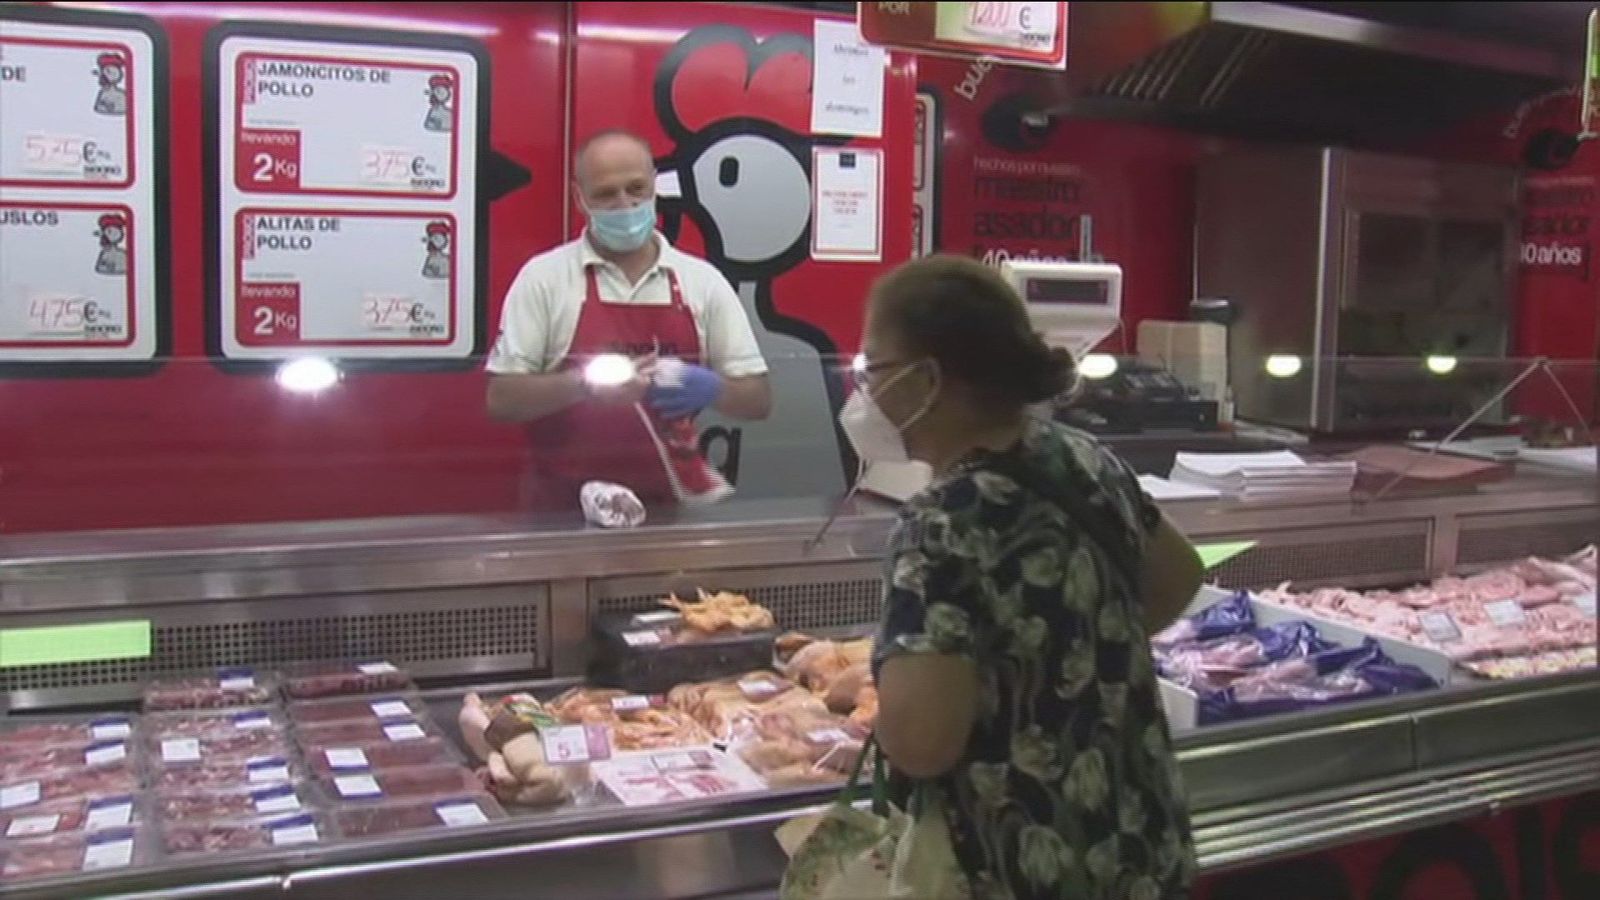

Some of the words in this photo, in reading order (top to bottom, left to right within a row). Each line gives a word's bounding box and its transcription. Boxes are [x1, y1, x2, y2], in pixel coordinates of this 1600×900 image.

[1, 65, 26, 83] DE
[258, 61, 363, 83] JAMONCITOS
[369, 68, 391, 84] DE
[258, 81, 314, 98] POLLO
[253, 153, 273, 182] 2
[274, 159, 298, 178] Kg
[257, 216, 316, 233] ALITAS
[318, 219, 341, 233] DE
[257, 234, 312, 251] POLLO
[253, 306, 274, 335] 2
[274, 312, 298, 332] Kg
